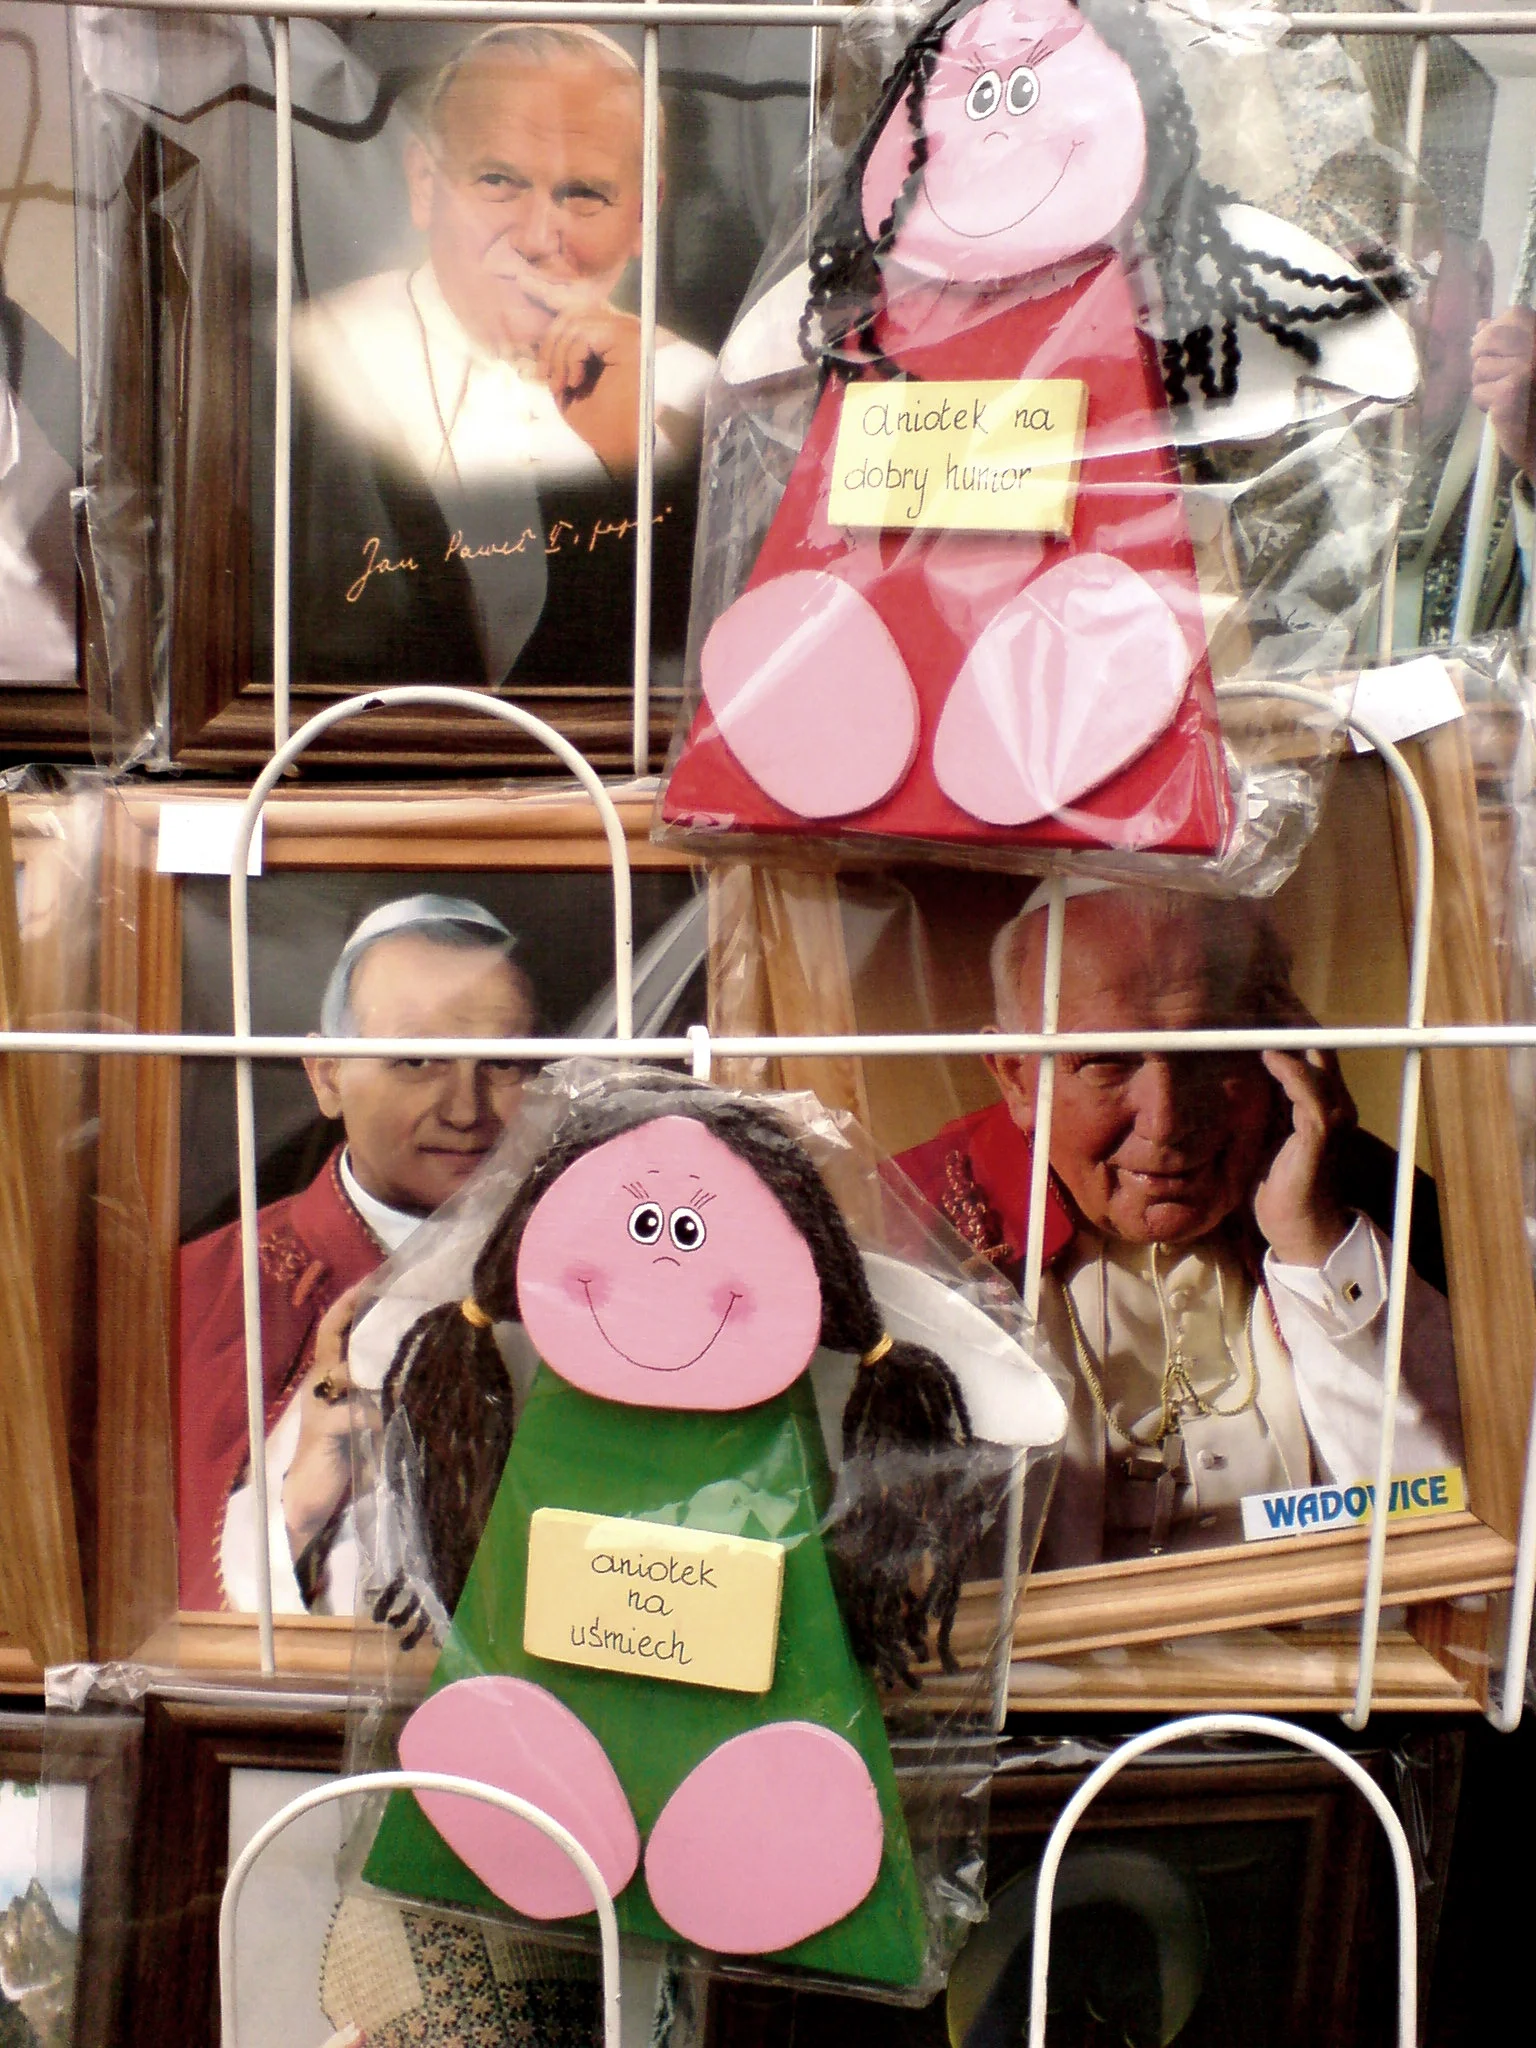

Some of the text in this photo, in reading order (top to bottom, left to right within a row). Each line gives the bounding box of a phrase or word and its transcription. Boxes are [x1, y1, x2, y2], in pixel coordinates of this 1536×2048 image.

[1014, 406, 1055, 431] na
[844, 452, 1032, 519] dobry humor
[346, 537, 419, 602] Jan
[591, 1553, 717, 1589] aniołek
[627, 1587, 674, 1617] na
[571, 1614, 693, 1666] uśmiech
